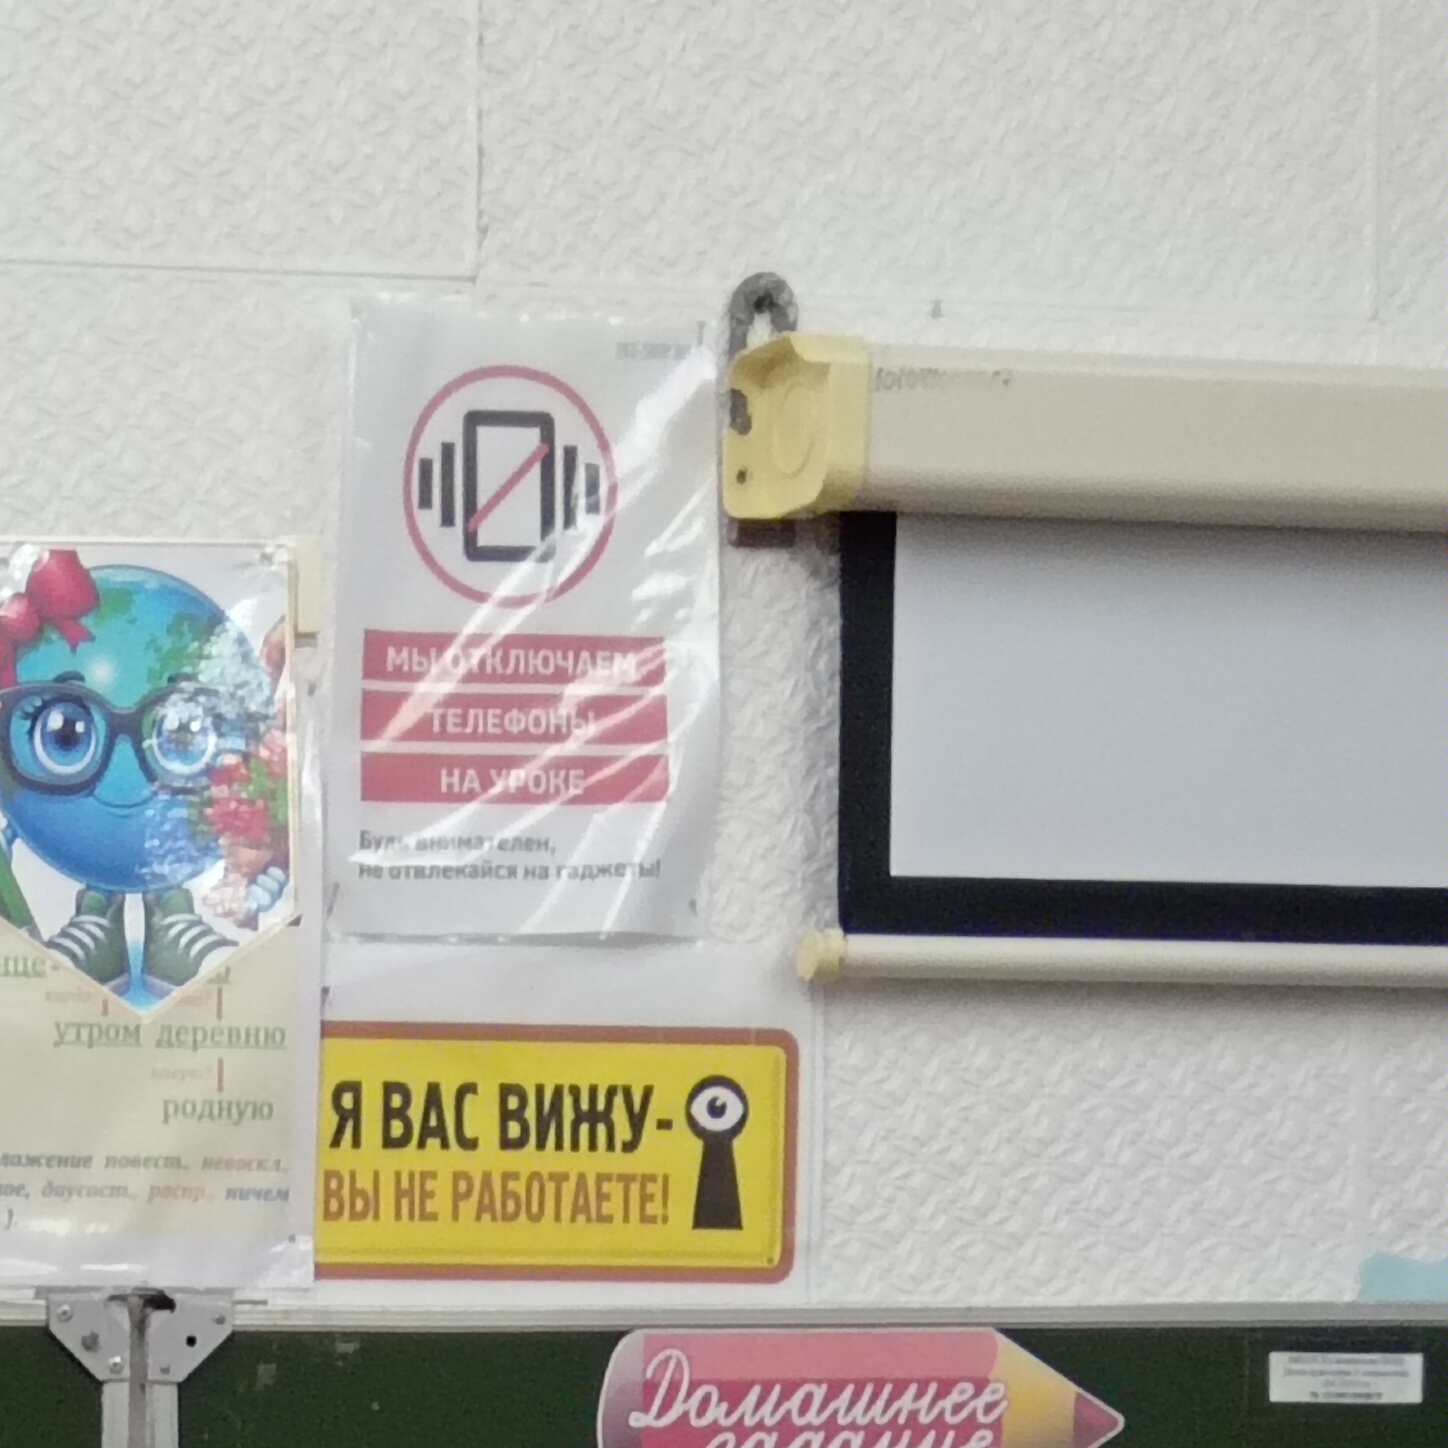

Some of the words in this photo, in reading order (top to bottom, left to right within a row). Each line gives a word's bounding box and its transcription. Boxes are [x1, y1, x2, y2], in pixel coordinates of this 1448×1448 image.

[386, 646, 437, 673] МЫ
[450, 647, 637, 677] ОТКЛЮЧАЕМ
[432, 707, 596, 736] ТЕЛЕФОНЫ
[440, 768, 482, 794] НА
[489, 768, 586, 795] УРОКЕ
[522, 864, 550, 881] на
[555, 859, 661, 883] гаджеы!
[53, 1020, 142, 1049] утром
[155, 1023, 287, 1050] деревню
[162, 1097, 274, 1126] родную
[328, 1080, 364, 1151] Я
[381, 1081, 480, 1152] ВАС
[322, 1169, 381, 1223] ВЫ
[393, 1170, 437, 1223] НЕ
[451, 1171, 671, 1226] РАБОТАЕТЕ!
[629, 1348, 1008, 1427] Домашнее
